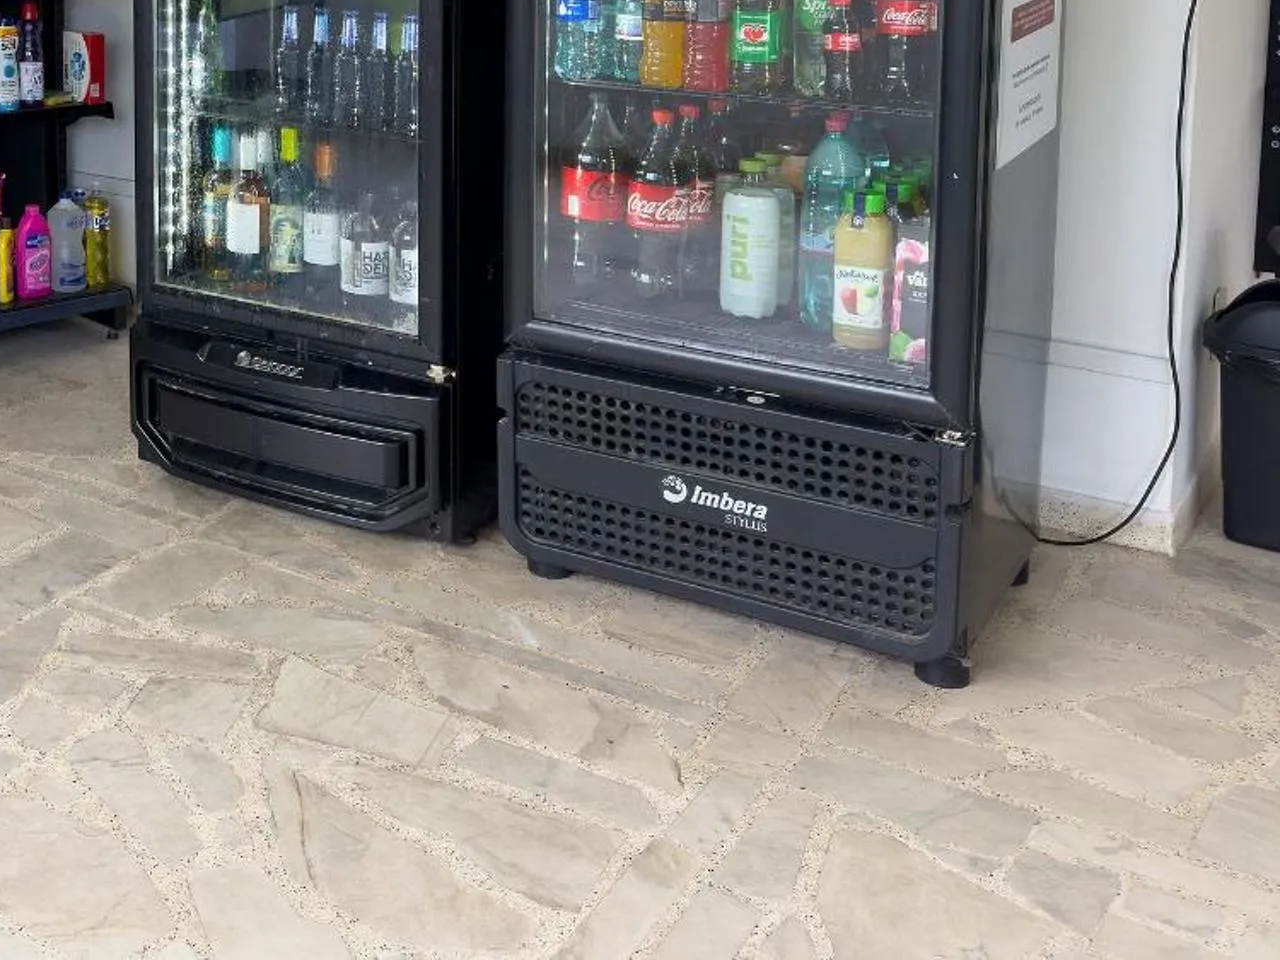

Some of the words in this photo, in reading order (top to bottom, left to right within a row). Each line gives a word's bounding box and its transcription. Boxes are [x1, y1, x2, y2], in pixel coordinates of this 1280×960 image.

[882, 8, 930, 27] Coca-Cola
[627, 192, 689, 222] Coca-Cola
[690, 484, 768, 520] Imbera
[724, 513, 768, 533] STYLUS
